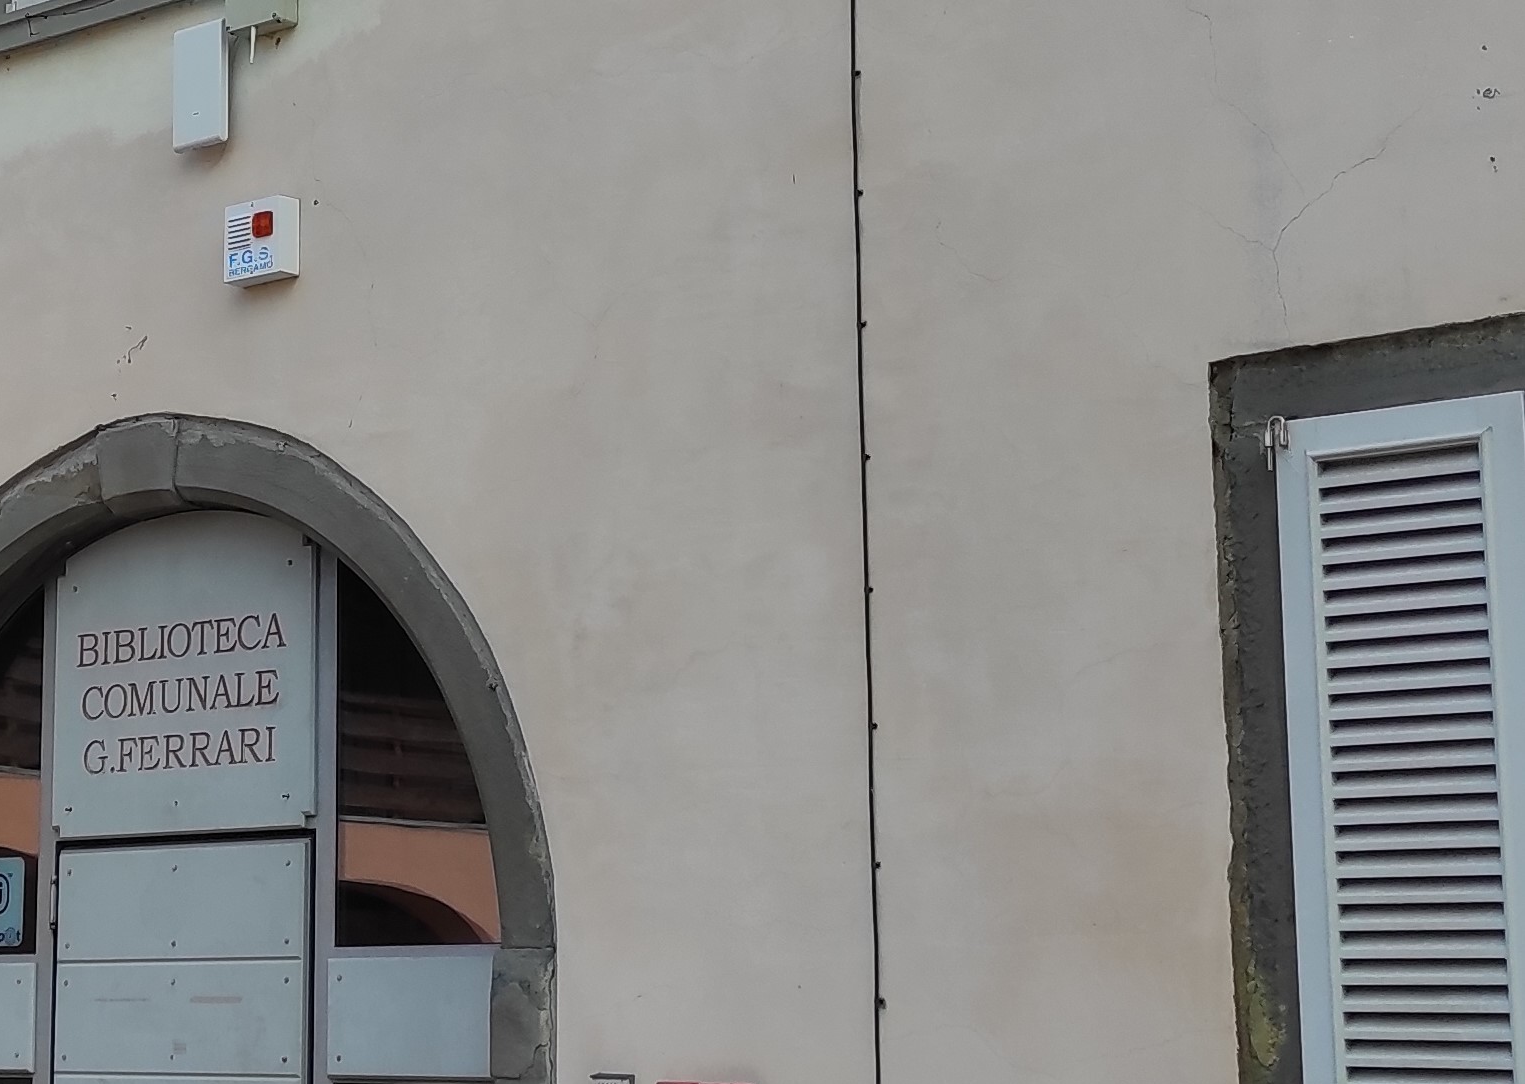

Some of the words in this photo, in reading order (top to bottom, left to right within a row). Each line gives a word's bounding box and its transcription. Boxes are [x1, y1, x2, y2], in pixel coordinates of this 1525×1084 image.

[228, 259, 274, 278] BERGAMO
[76, 612, 287, 669] BIBLIOTECA
[81, 669, 281, 721] COMUNALE
[82, 725, 277, 776] G.FERRARI
